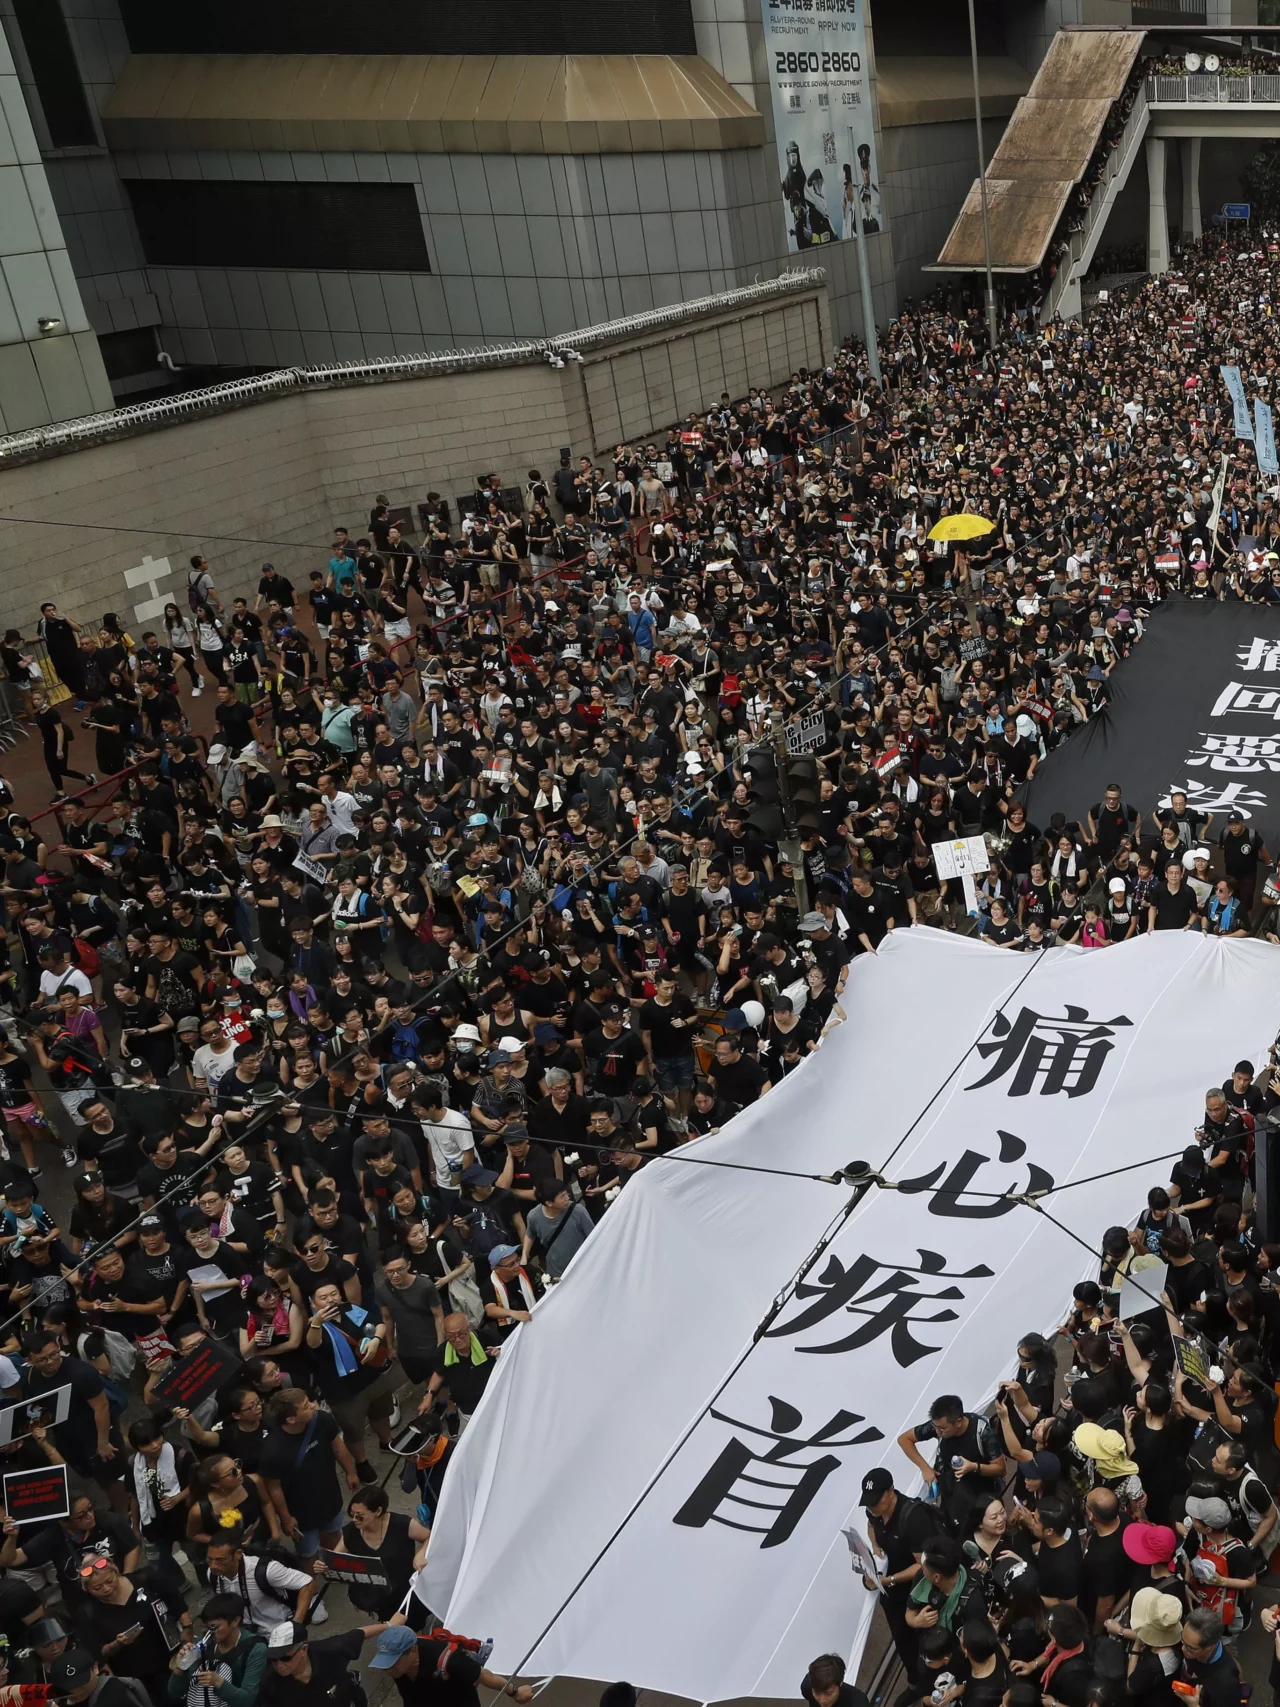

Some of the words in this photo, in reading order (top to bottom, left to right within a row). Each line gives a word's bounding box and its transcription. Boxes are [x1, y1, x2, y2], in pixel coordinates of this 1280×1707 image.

[771, 26, 809, 34] RECRUITMENT
[818, 21, 838, 31] APPLY
[841, 22, 857, 31] NOW
[774, 52, 819, 73] 2860
[821, 52, 861, 72] 2860
[801, 713, 824, 731] City
[790, 734, 802, 747] Of
[219, 1017, 232, 1030] OP
[672, 1003, 1134, 1549] 痛心疾首
